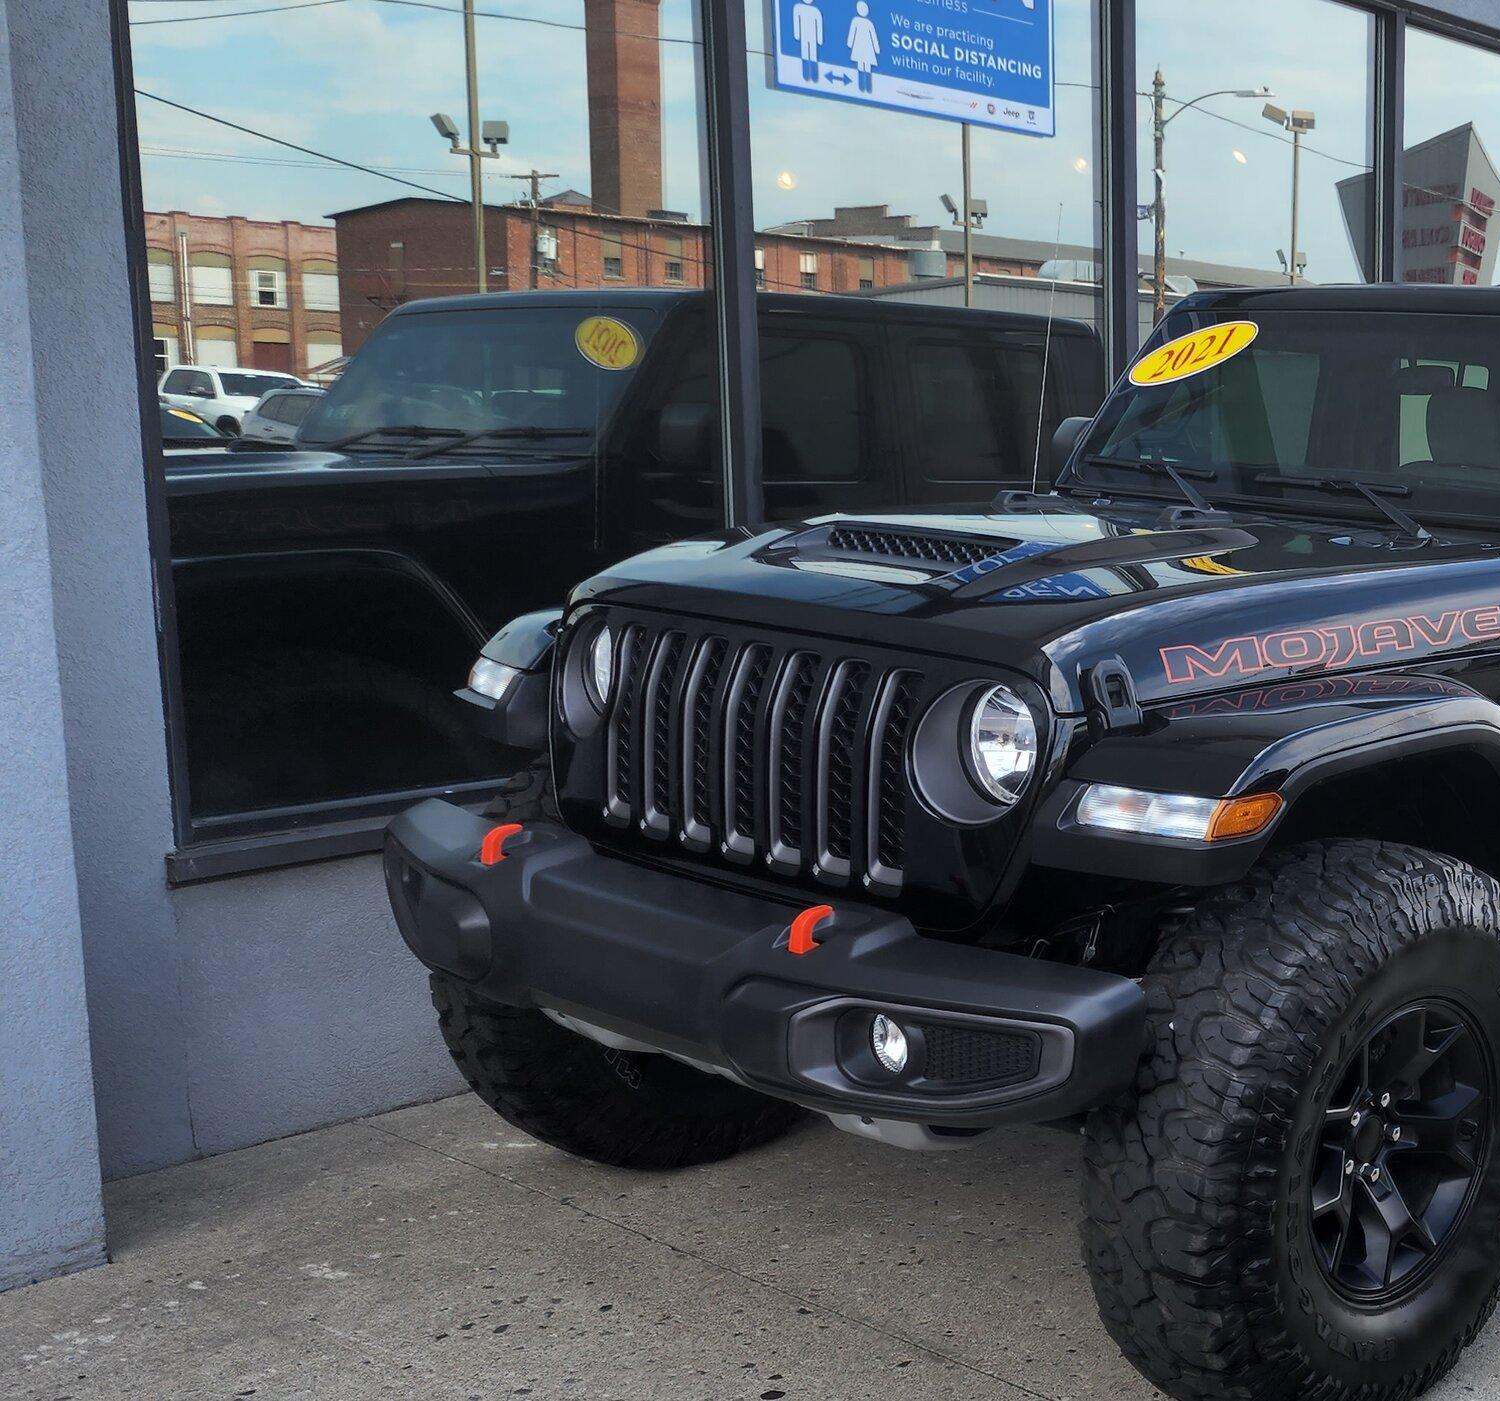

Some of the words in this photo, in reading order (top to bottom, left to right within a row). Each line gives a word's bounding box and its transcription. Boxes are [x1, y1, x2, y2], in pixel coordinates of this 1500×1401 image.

[890, 12, 910, 29] We
[914, 20, 933, 34] are
[936, 26, 994, 50] practicing
[891, 32, 950, 60] SOCIAL
[954, 46, 1042, 79] DISTANCING
[891, 54, 929, 72] within
[931, 63, 951, 77] our
[955, 66, 995, 88] facility.
[1003, 107, 1020, 118] Jeep
[1148, 326, 1238, 380] 2021
